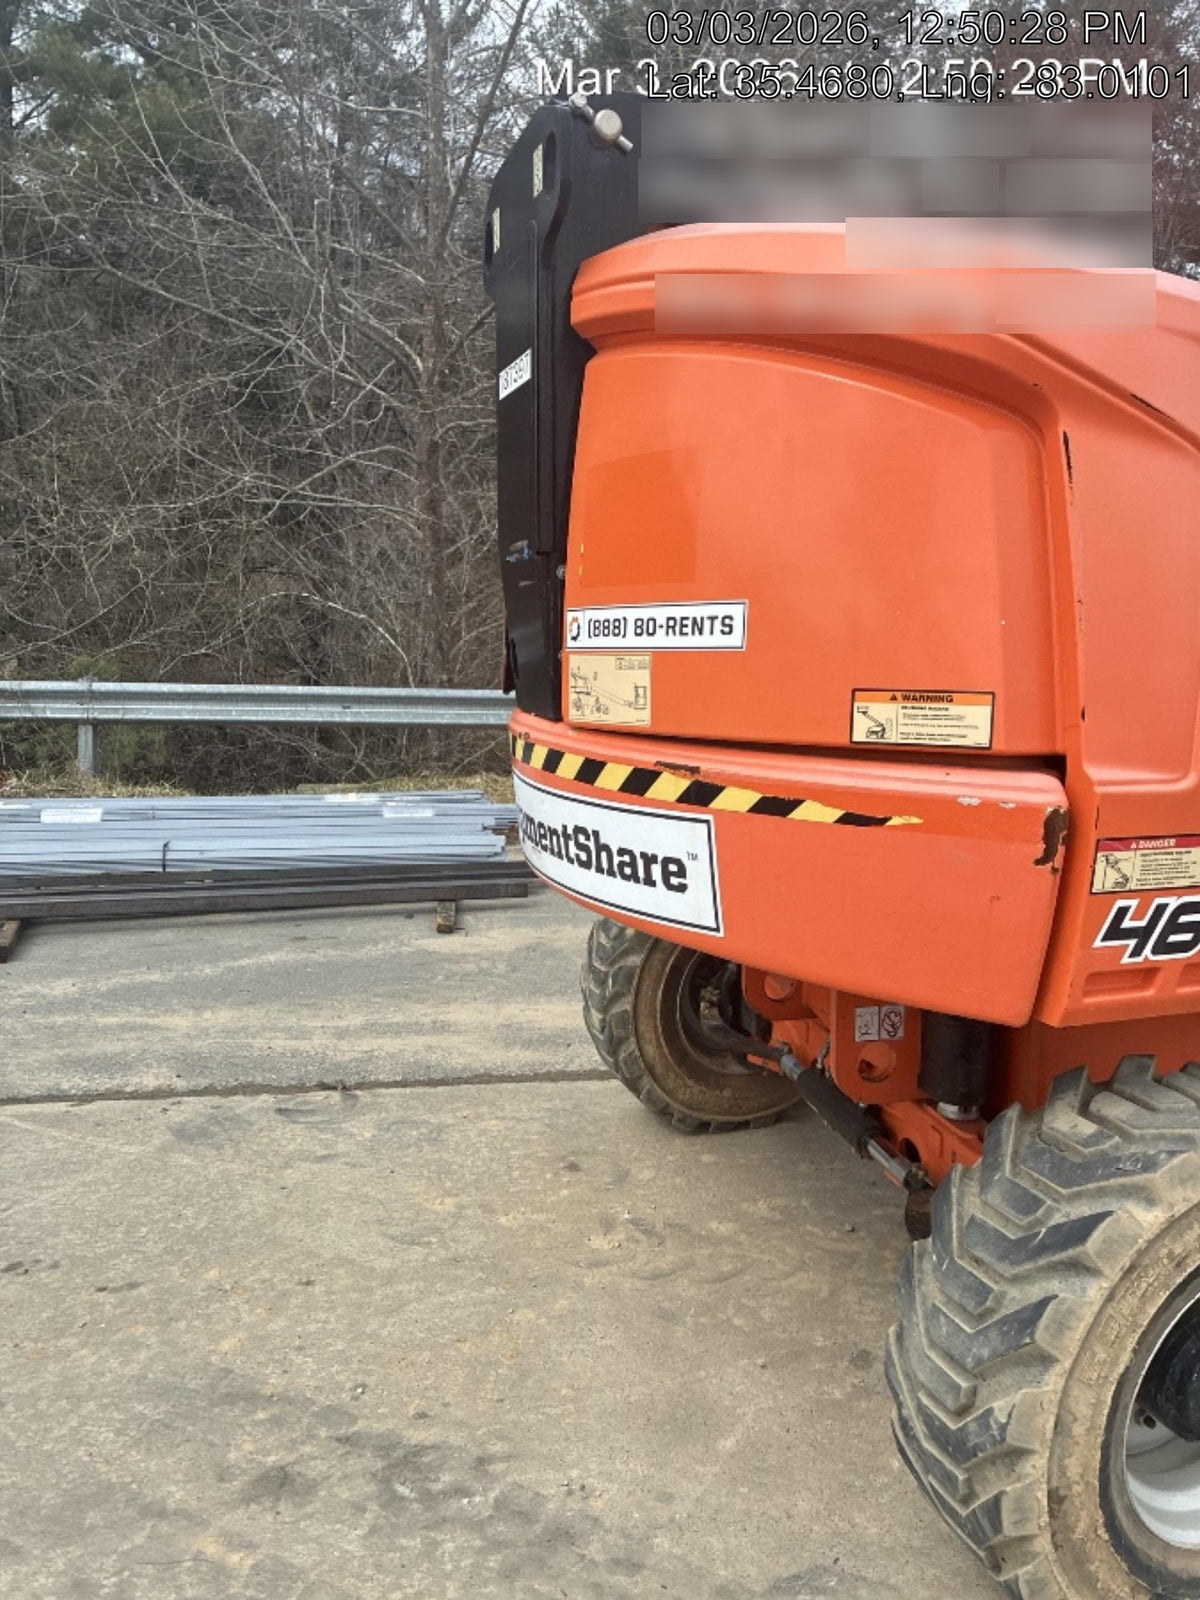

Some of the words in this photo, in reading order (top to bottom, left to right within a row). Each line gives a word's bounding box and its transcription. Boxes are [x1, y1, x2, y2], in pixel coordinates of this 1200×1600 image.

[587, 617, 628, 639] (888)
[634, 614, 734, 637] 80-RENTS
[901, 693, 954, 704] WARNING
[1138, 838, 1177, 850] DANGER
